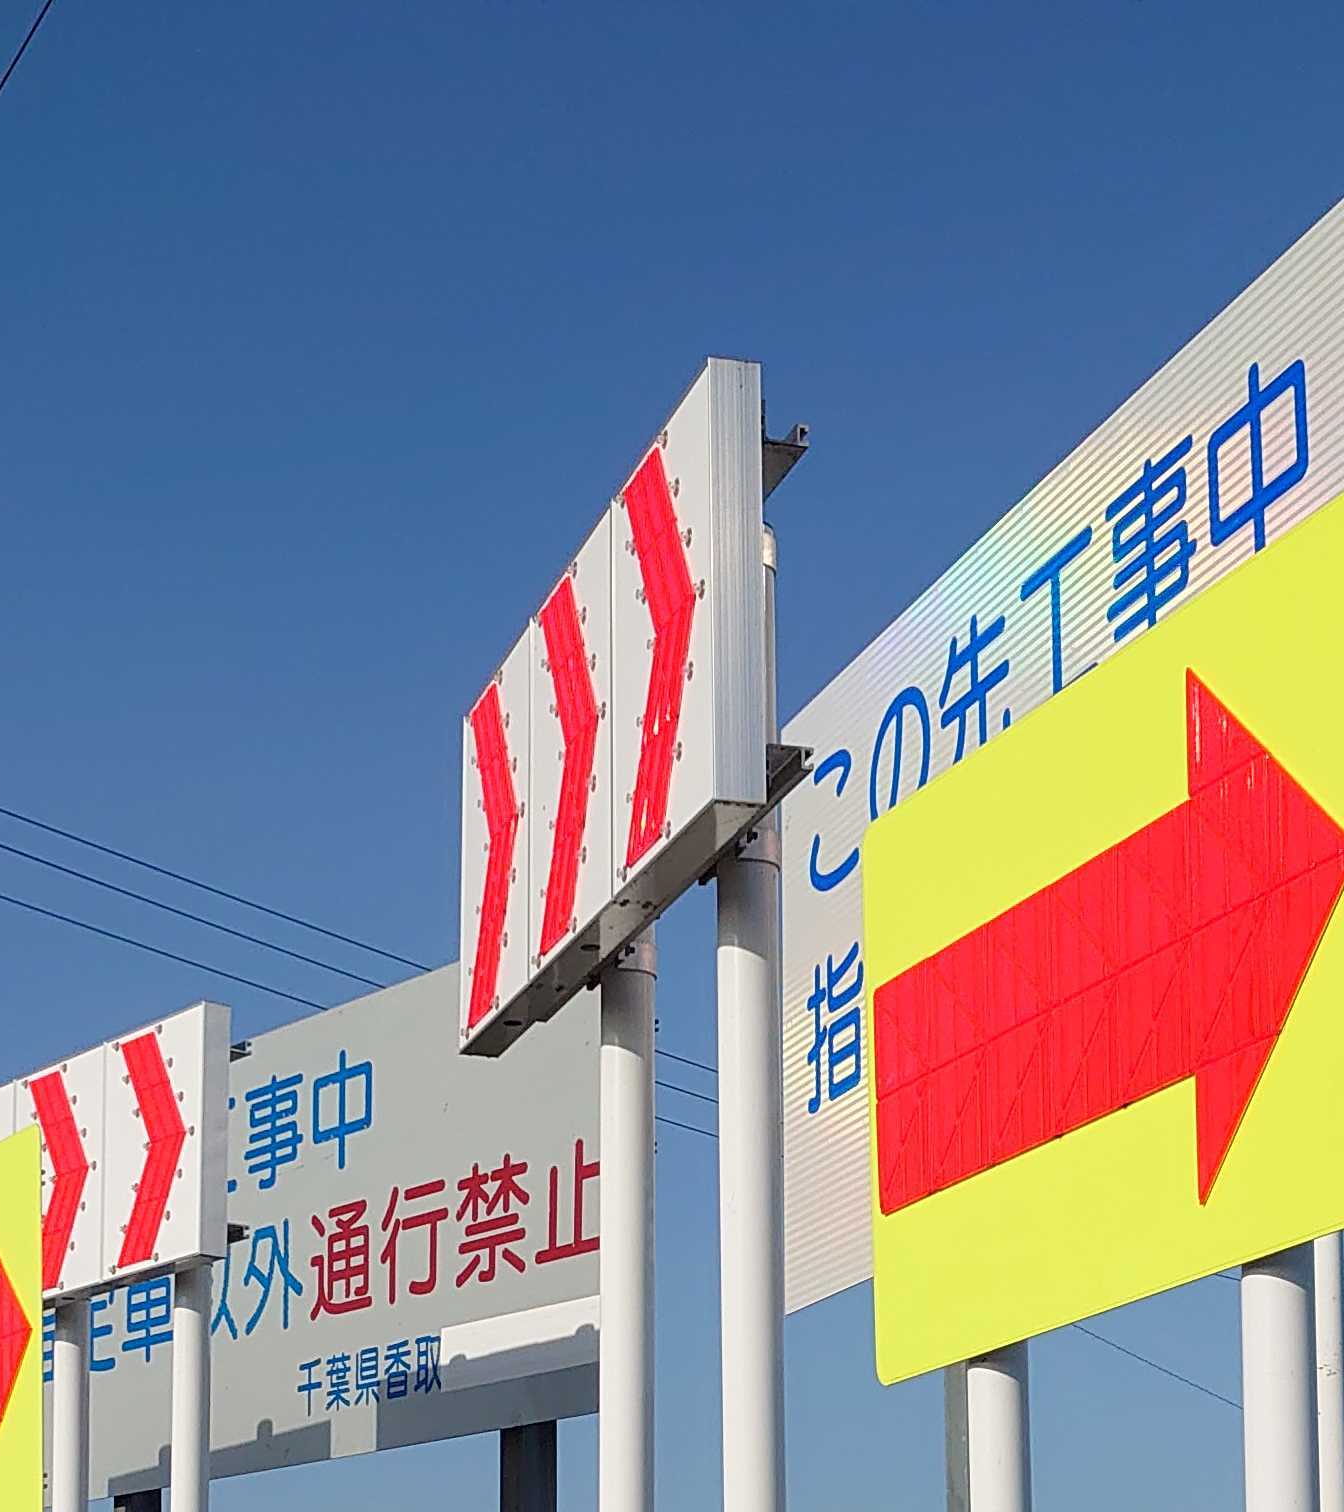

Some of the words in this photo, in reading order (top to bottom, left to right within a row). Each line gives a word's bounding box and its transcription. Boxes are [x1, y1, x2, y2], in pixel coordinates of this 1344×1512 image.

[809, 359, 1309, 892] この先工事中
[228, 1049, 373, 1190] 事中
[297, 1334, 442, 1417] 千葉県香取
